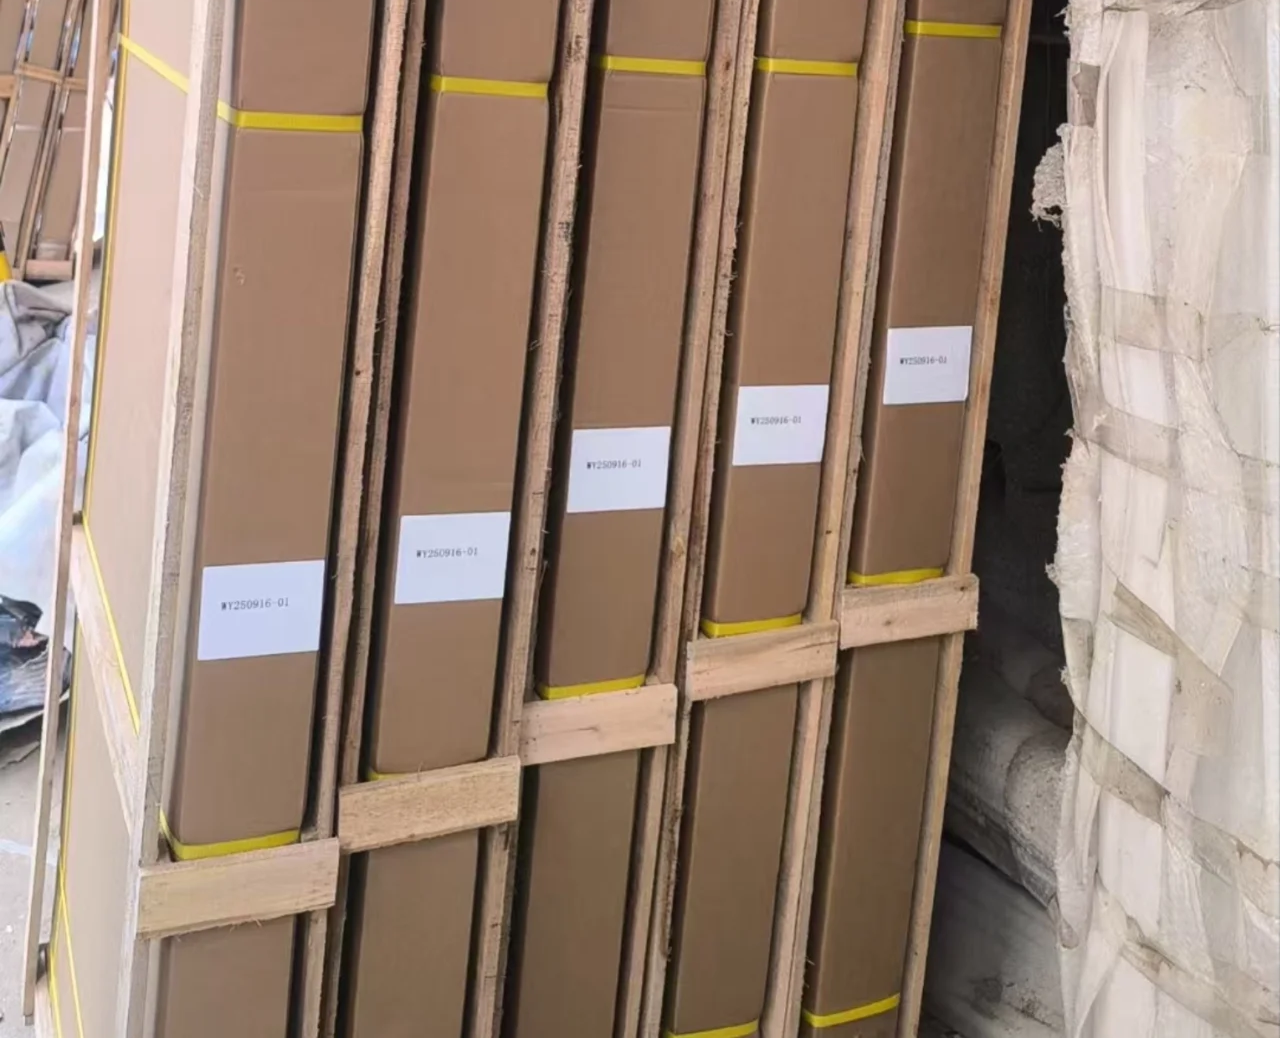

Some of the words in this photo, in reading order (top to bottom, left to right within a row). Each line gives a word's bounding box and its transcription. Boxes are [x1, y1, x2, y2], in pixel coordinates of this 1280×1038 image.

[899, 355, 948, 366] WY250916-01
[750, 415, 802, 425] WY250916-01
[586, 458, 642, 470] WY250916-01
[416, 547, 478, 559] WY250916-01
[221, 597, 289, 611] WY250916-01
